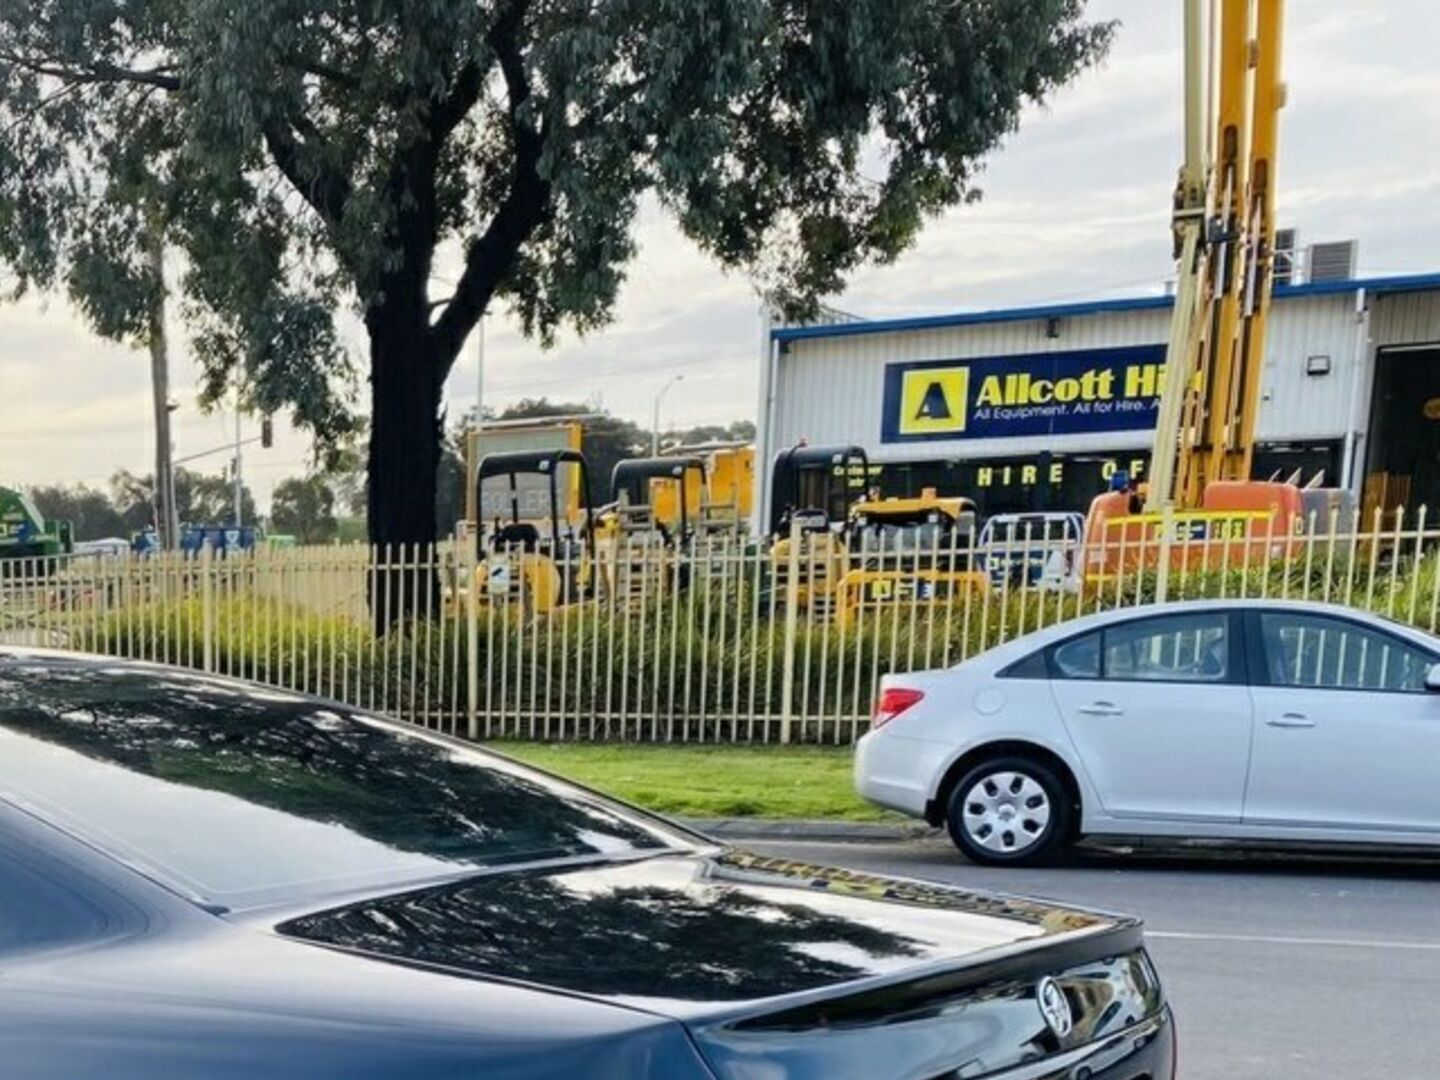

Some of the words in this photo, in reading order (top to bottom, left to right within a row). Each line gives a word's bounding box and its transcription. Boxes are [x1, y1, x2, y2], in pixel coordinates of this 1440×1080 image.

[975, 368, 1115, 407] Allcott
[1124, 363, 1170, 398] Hi
[973, 408, 991, 420] All
[993, 403, 1070, 420] Equipment.
[1073, 402, 1091, 415] All
[1093, 400, 1112, 413] for
[1115, 398, 1147, 412] Hire.
[977, 463, 1063, 487] HIRE
